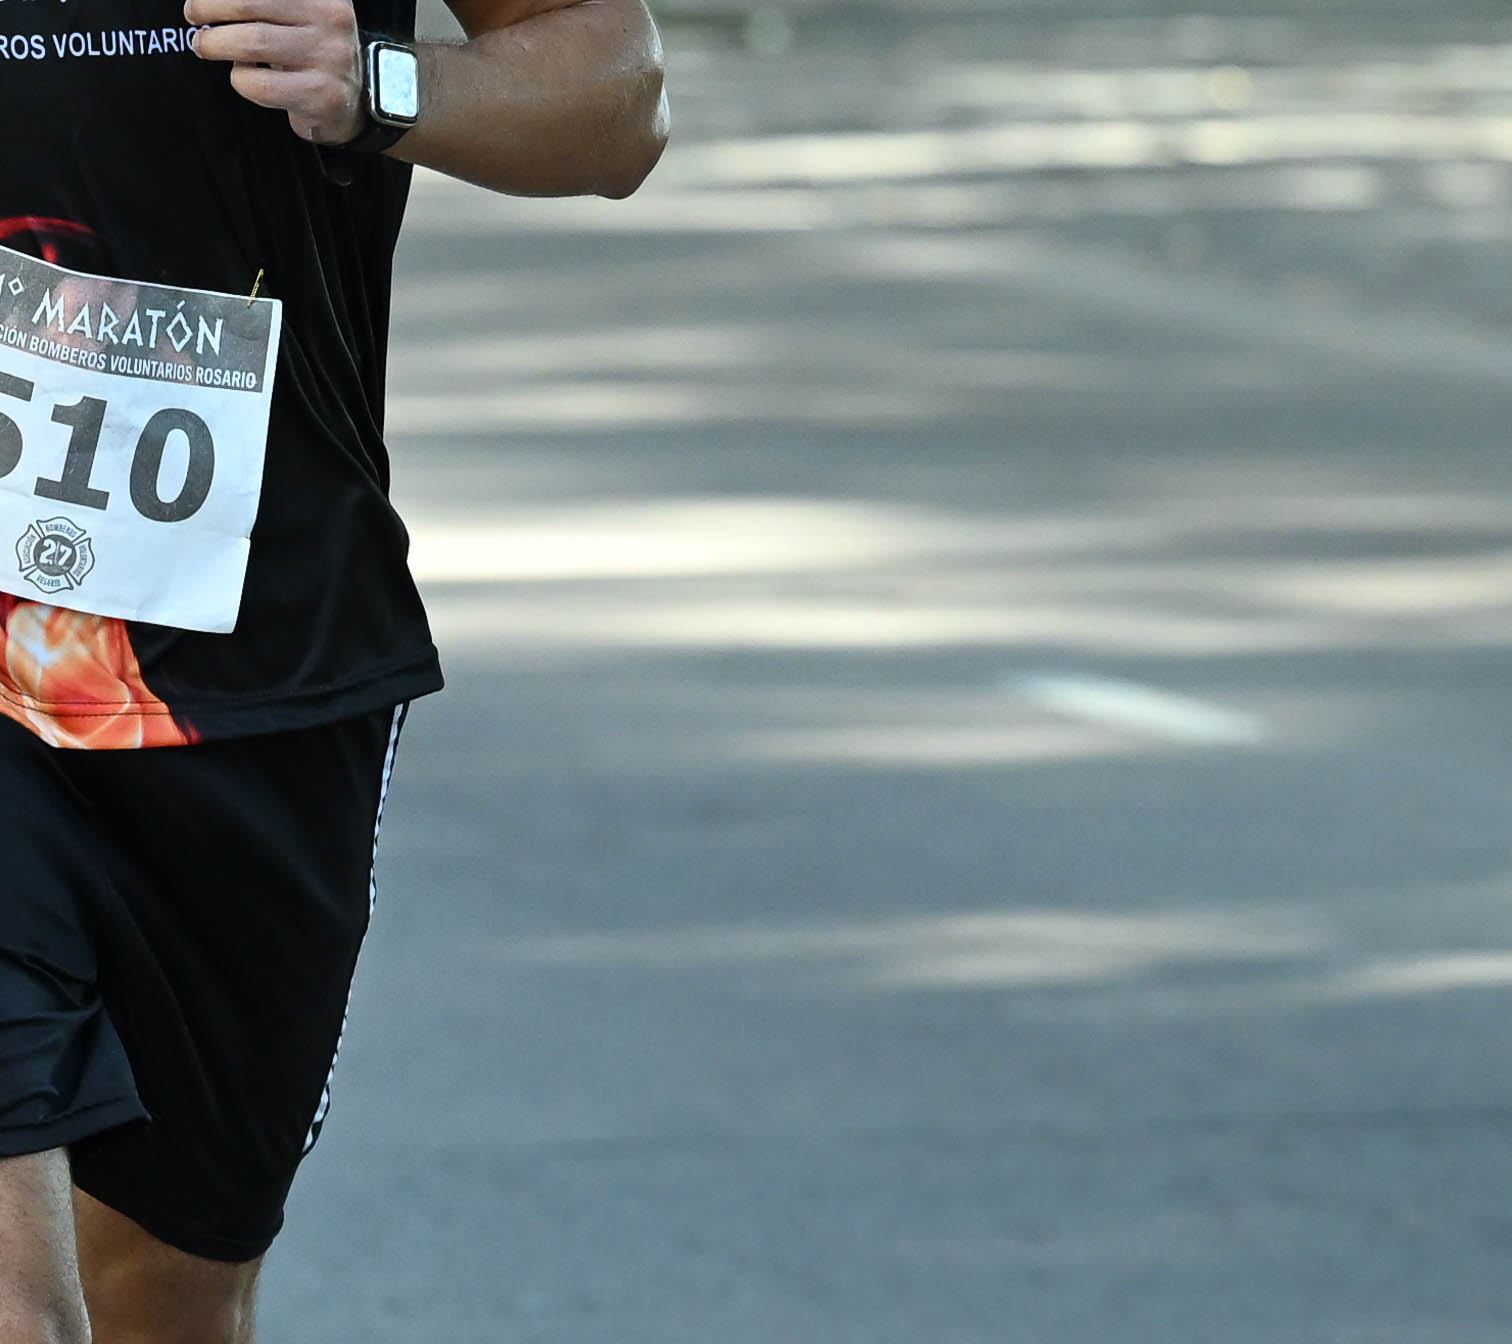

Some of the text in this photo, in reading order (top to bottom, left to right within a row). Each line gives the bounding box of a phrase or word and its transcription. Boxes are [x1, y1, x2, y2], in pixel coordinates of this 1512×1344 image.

[52, 24, 213, 58] VOLUNTARI
[31, 288, 224, 356] MARATÓN
[29, 335, 107, 370] BOMBEROS
[110, 355, 193, 382] VOLUNTARIOS
[195, 367, 257, 389] ROSARIO
[40, 538, 73, 566] 27
